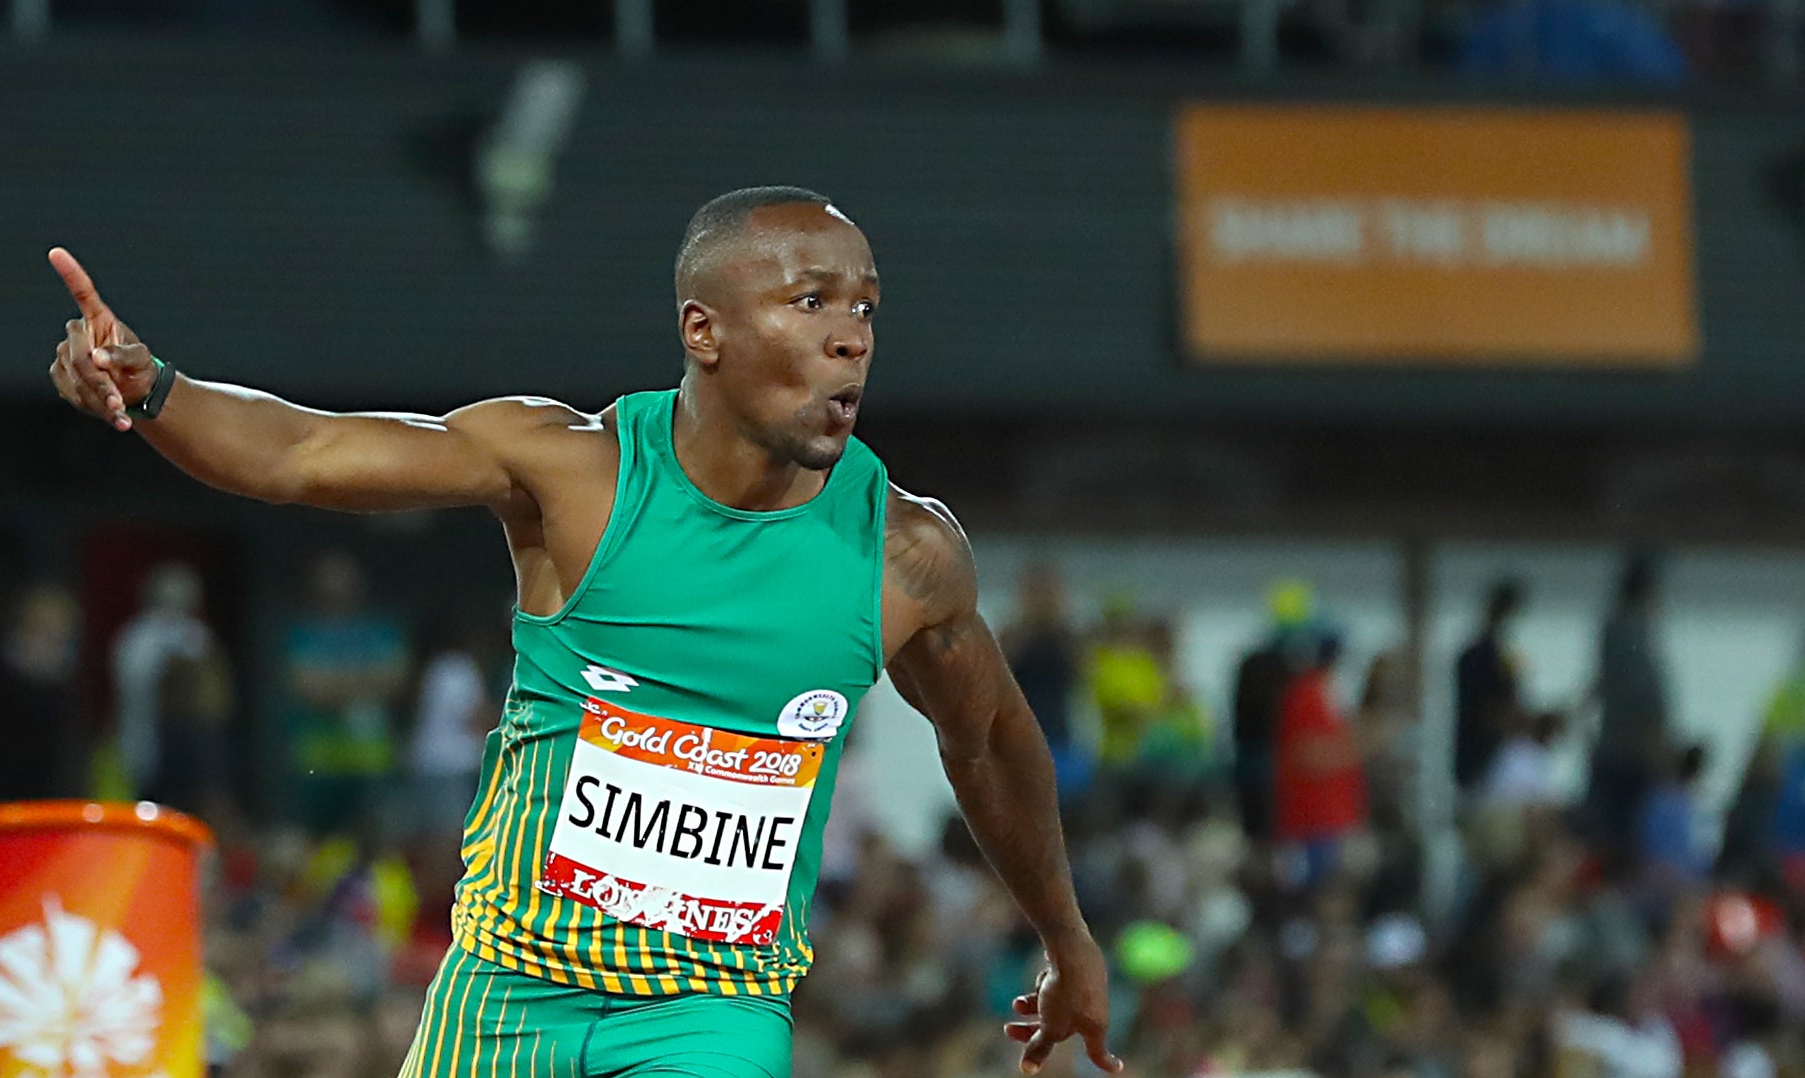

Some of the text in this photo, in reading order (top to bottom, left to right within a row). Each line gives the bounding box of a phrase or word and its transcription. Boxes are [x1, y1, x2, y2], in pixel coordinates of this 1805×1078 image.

[601, 716, 802, 777] Gold Coast 2018
[569, 775, 794, 870] SIMBINE
[570, 868, 754, 937] LONINES
